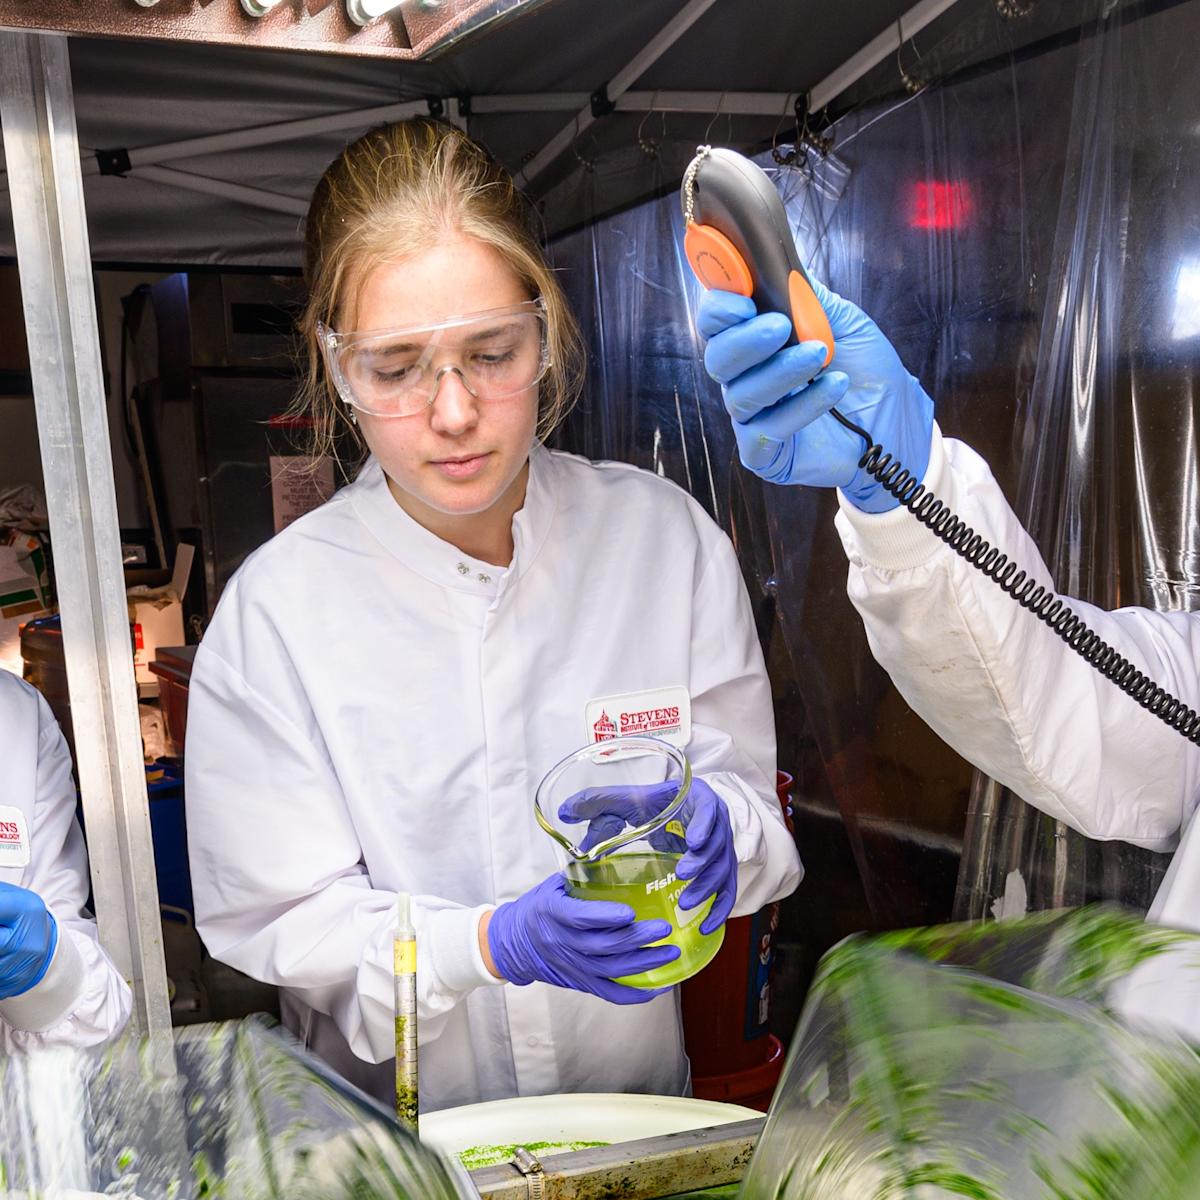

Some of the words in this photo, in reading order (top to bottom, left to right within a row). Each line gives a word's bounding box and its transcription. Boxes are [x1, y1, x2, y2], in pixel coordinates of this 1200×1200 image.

[620, 707, 679, 725] STEVENS
[621, 724, 642, 733] INSTITUTE
[649, 718, 680, 728] TECHNOLOGY
[0, 822, 18, 833] NS
[646, 872, 677, 895] Fish
